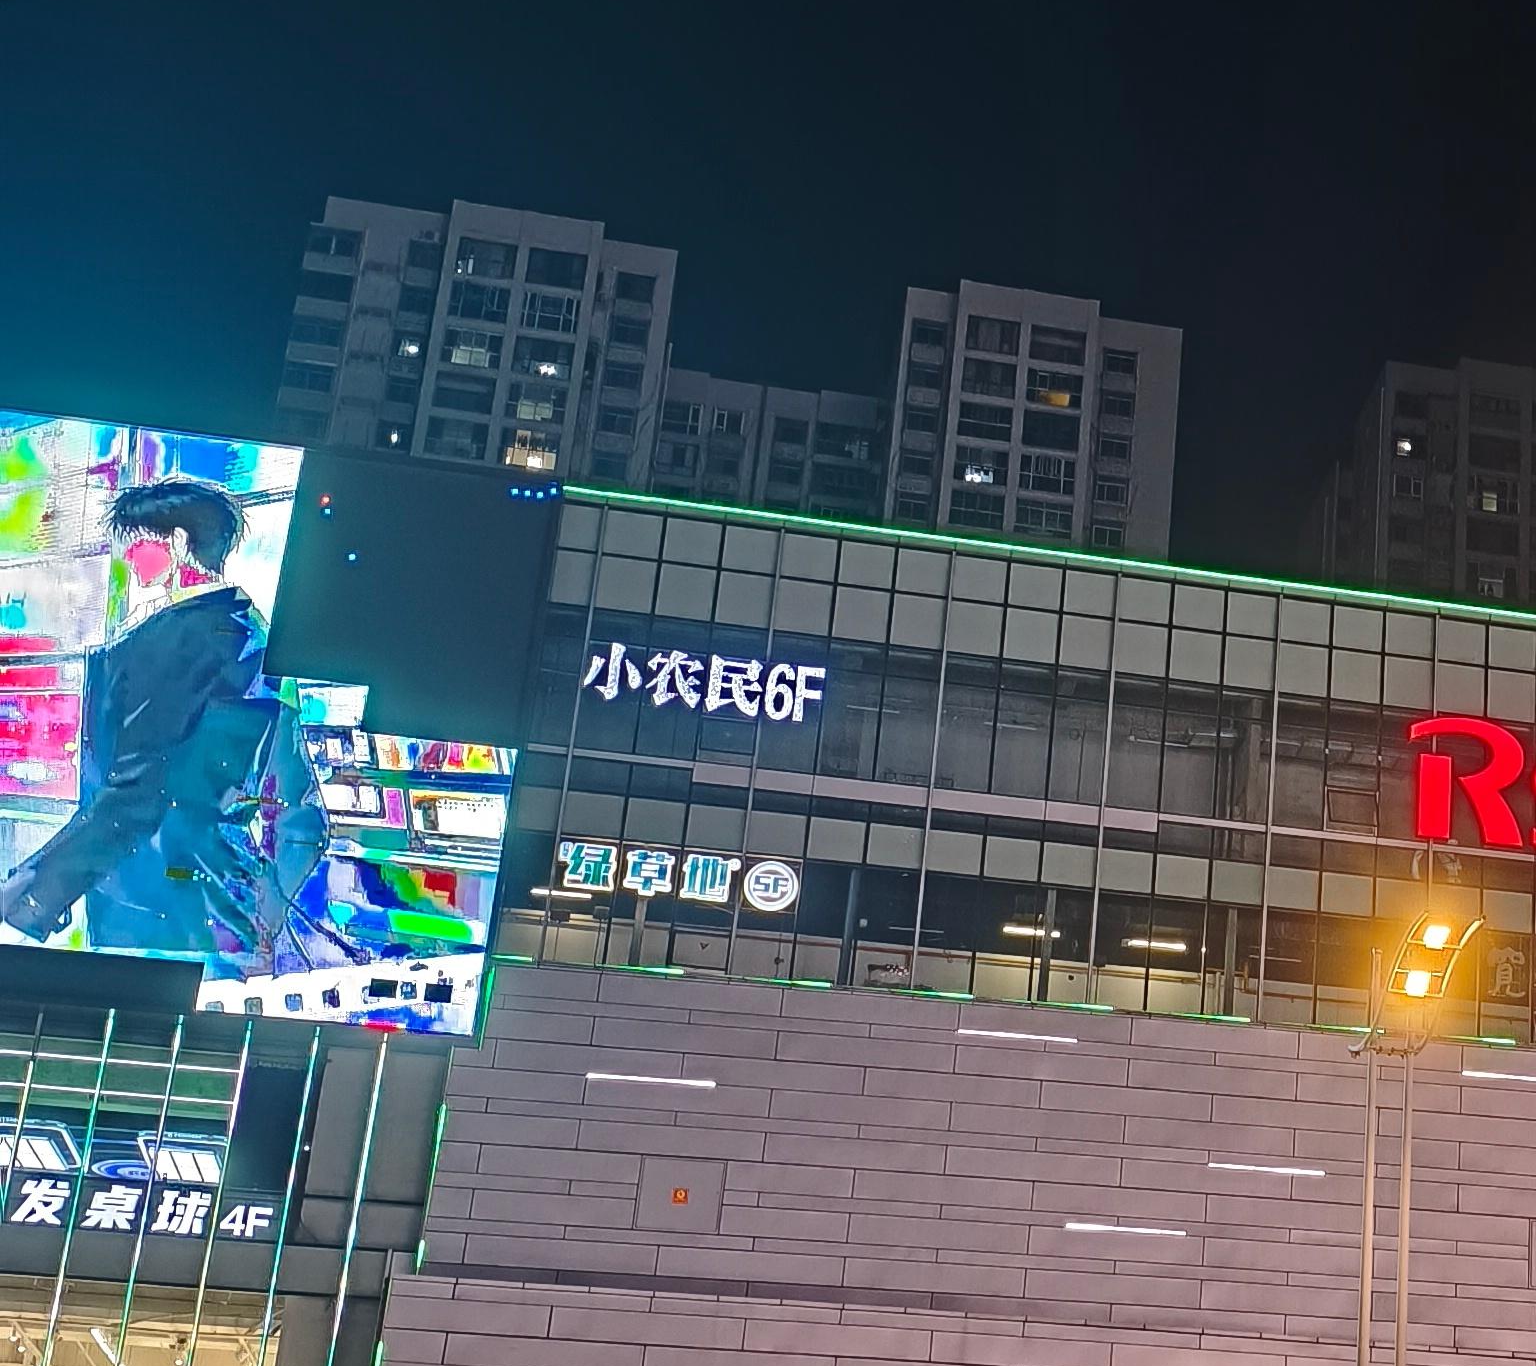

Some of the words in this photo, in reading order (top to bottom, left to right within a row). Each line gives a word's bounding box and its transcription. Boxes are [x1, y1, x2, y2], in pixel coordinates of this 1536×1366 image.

[581, 642, 826, 722] 小农民6F
[10, 1179, 212, 1235] 发桌球
[219, 1204, 274, 1238] 4F
